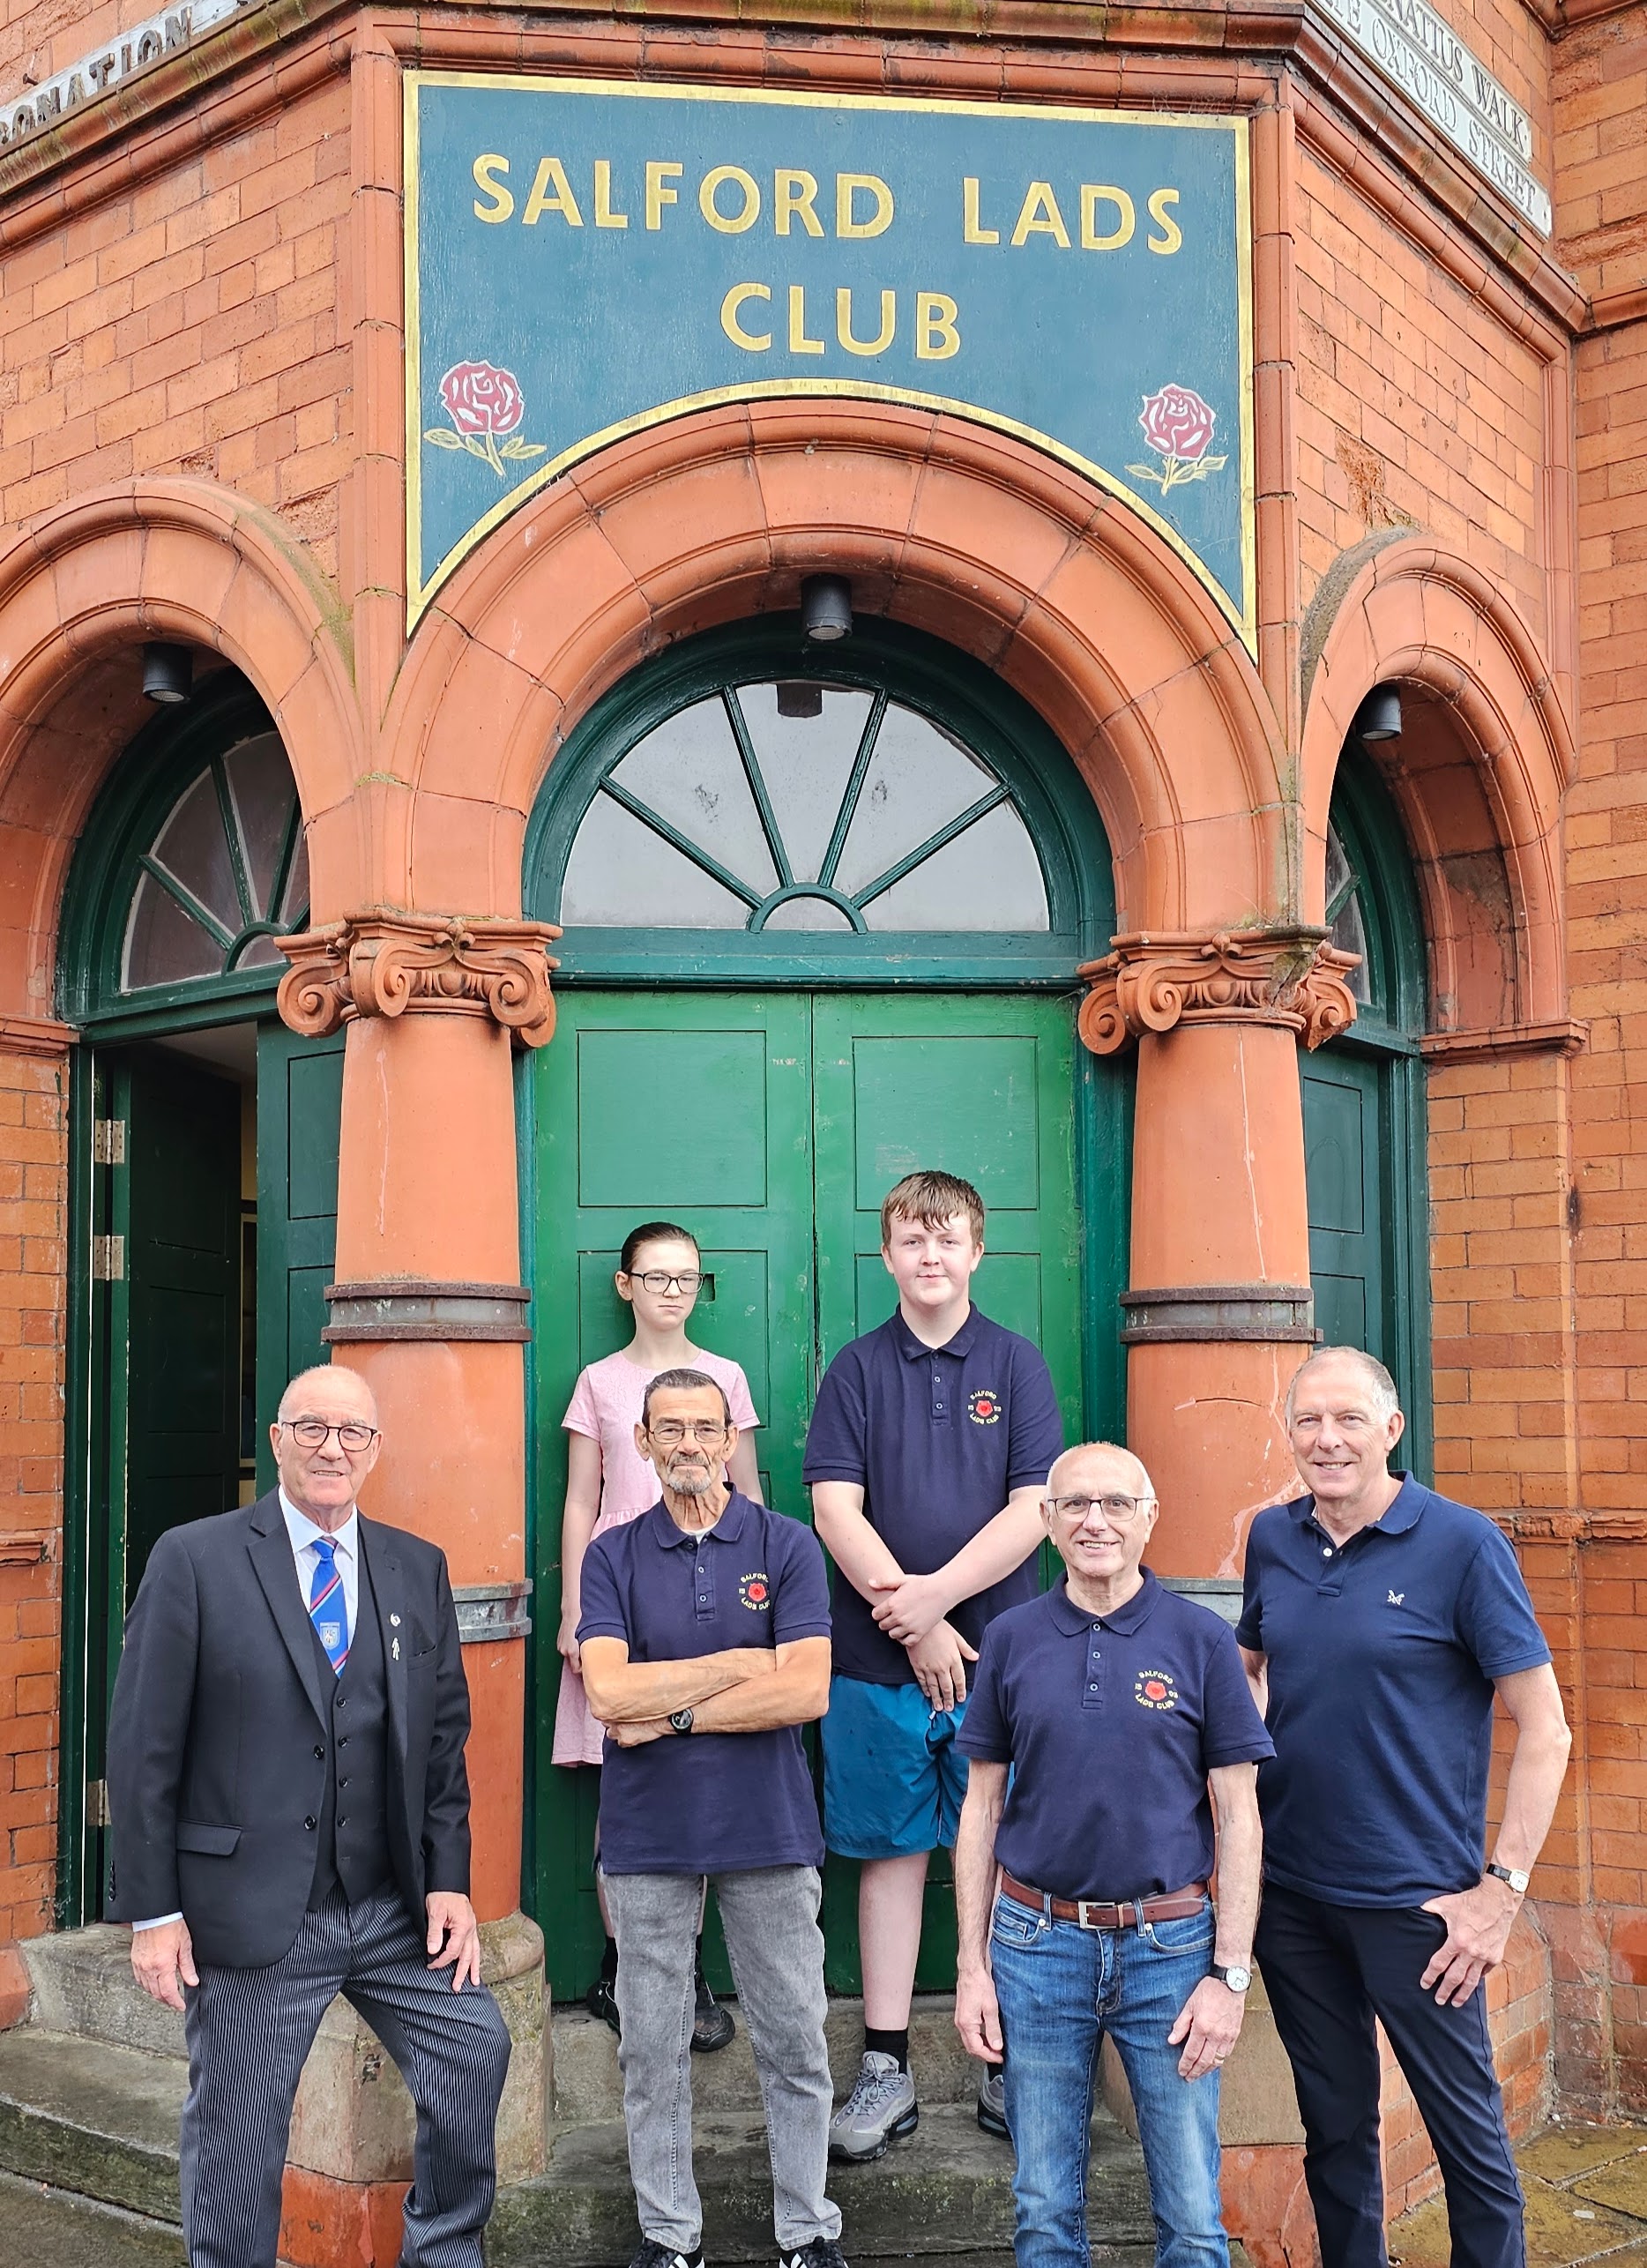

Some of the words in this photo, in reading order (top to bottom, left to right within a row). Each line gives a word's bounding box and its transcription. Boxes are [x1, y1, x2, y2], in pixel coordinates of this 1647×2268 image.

[1373, 18, 1457, 132] OXFORD
[1469, 119, 1536, 215] STREET
[1472, 63, 1524, 153] WALK
[471, 152, 895, 240] SALFORD
[963, 176, 1182, 256] LADS
[719, 281, 962, 360] CLUB
